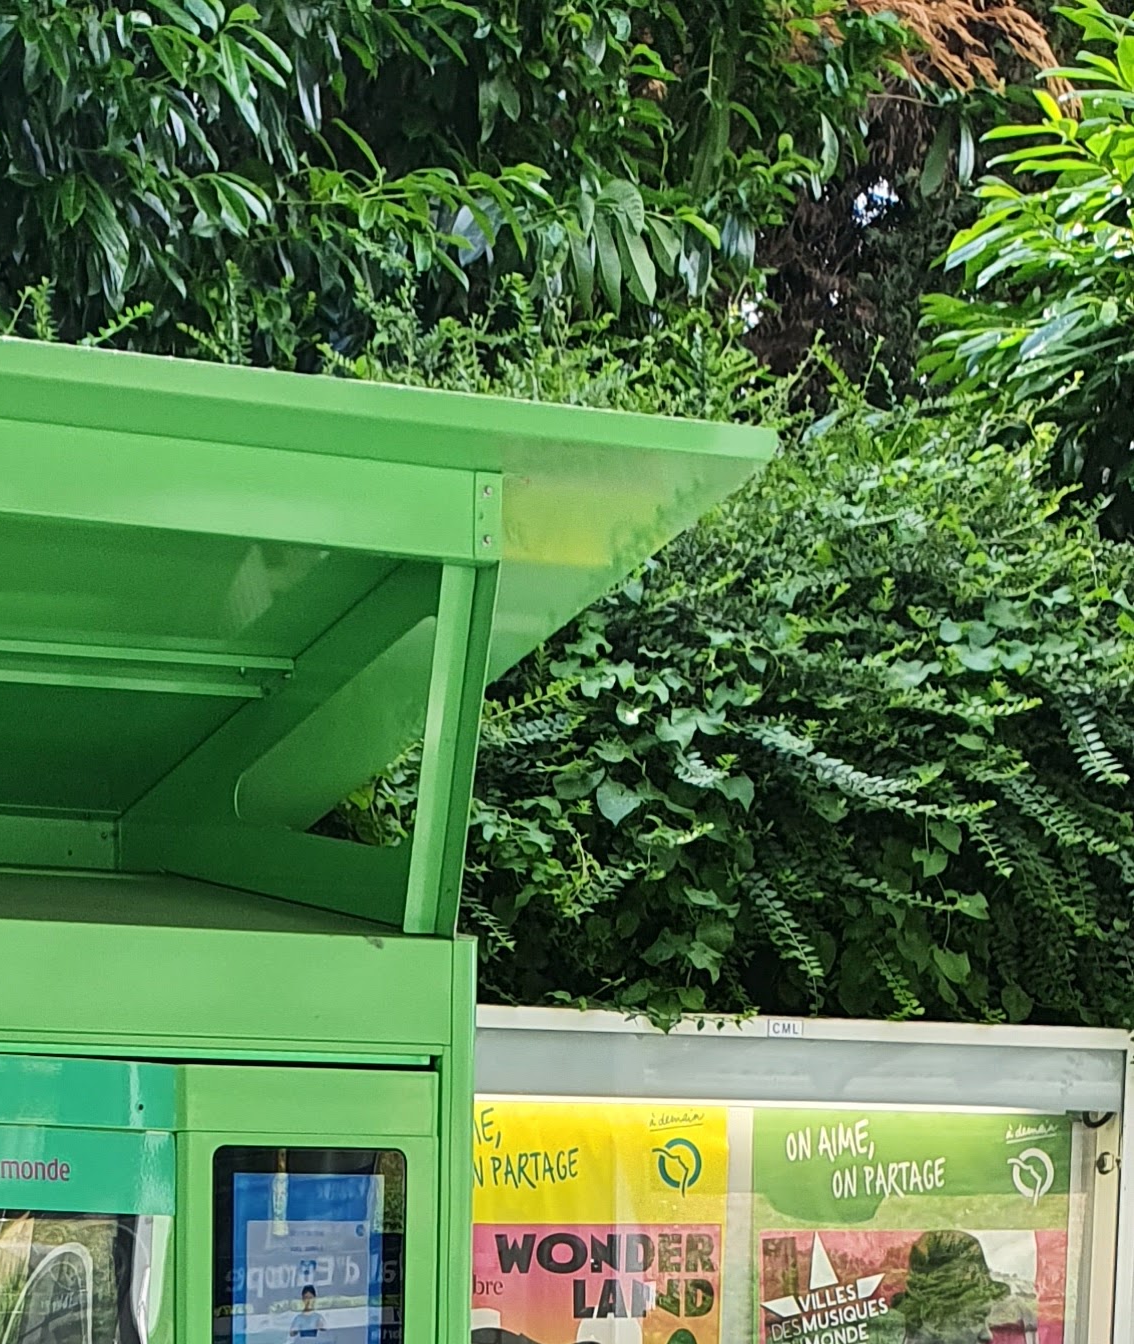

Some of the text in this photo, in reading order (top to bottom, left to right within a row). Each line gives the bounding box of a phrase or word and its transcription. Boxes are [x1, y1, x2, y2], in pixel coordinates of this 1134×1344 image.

[772, 1022, 799, 1035] CML
[786, 1119, 876, 1162] ON AIME,
[1, 1155, 71, 1182] monde
[491, 1147, 579, 1189] PARTAGE
[832, 1157, 946, 1199] ON PARTAGE
[495, 1232, 716, 1274] WONDER
[573, 1278, 715, 1319] LAND
[798, 1283, 857, 1312] VILLES
